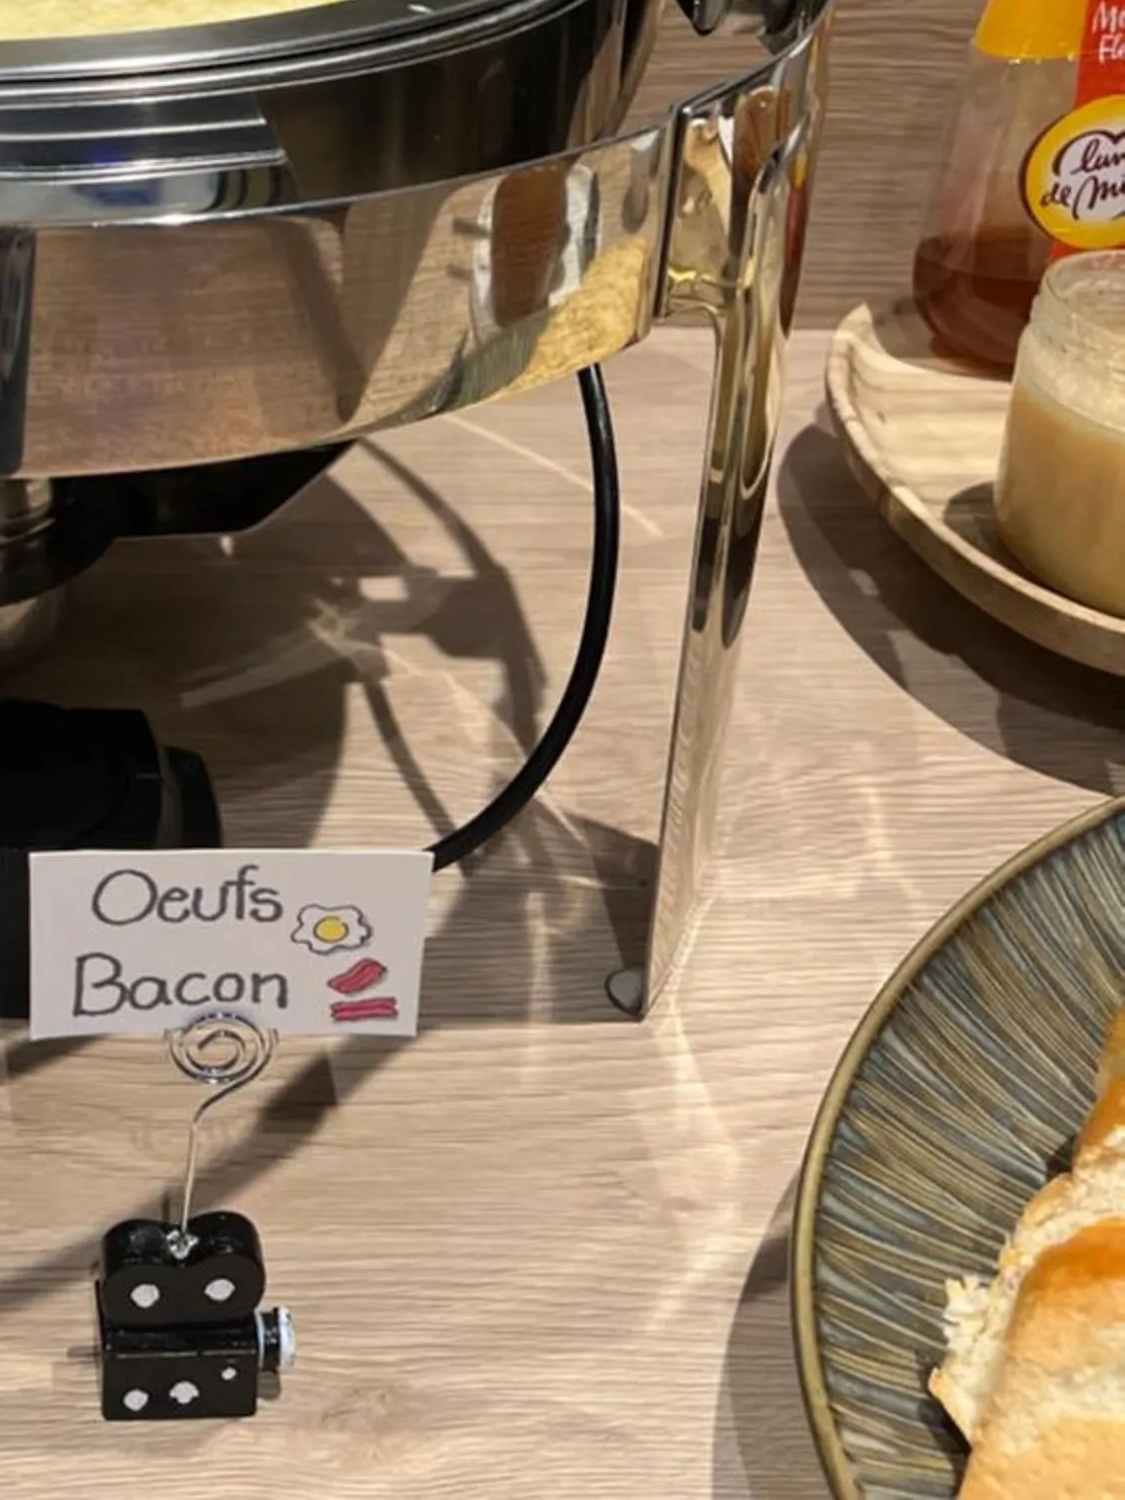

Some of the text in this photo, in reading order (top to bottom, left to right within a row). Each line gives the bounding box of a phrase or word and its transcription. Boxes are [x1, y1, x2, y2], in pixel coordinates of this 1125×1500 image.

[1040, 182, 1072, 208] de
[91, 864, 284, 925] Oeufs
[72, 952, 288, 1017] Bacon
